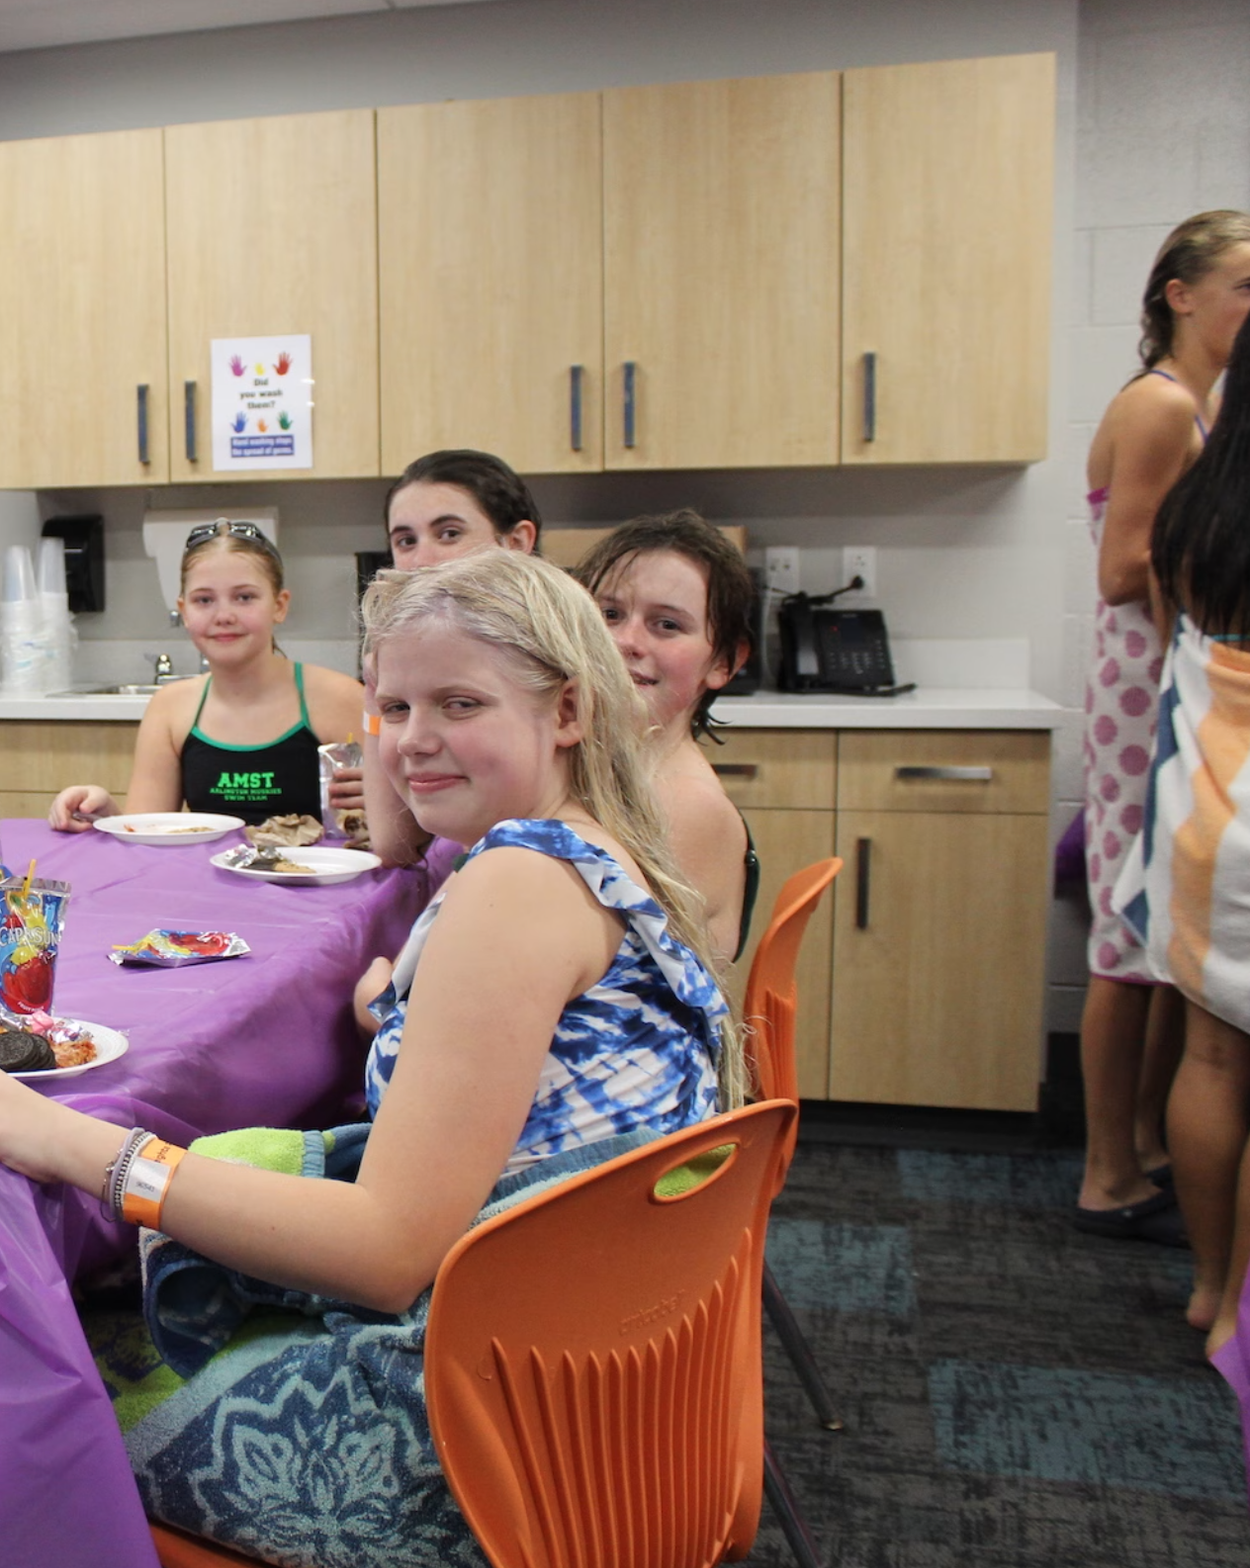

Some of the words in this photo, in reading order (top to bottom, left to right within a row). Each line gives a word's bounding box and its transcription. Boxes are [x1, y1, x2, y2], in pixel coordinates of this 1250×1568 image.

[253, 378, 269, 387] Did
[240, 391, 256, 400] you
[259, 388, 283, 397] wash
[247, 400, 276, 410] them?
[217, 772, 275, 788] AMST
